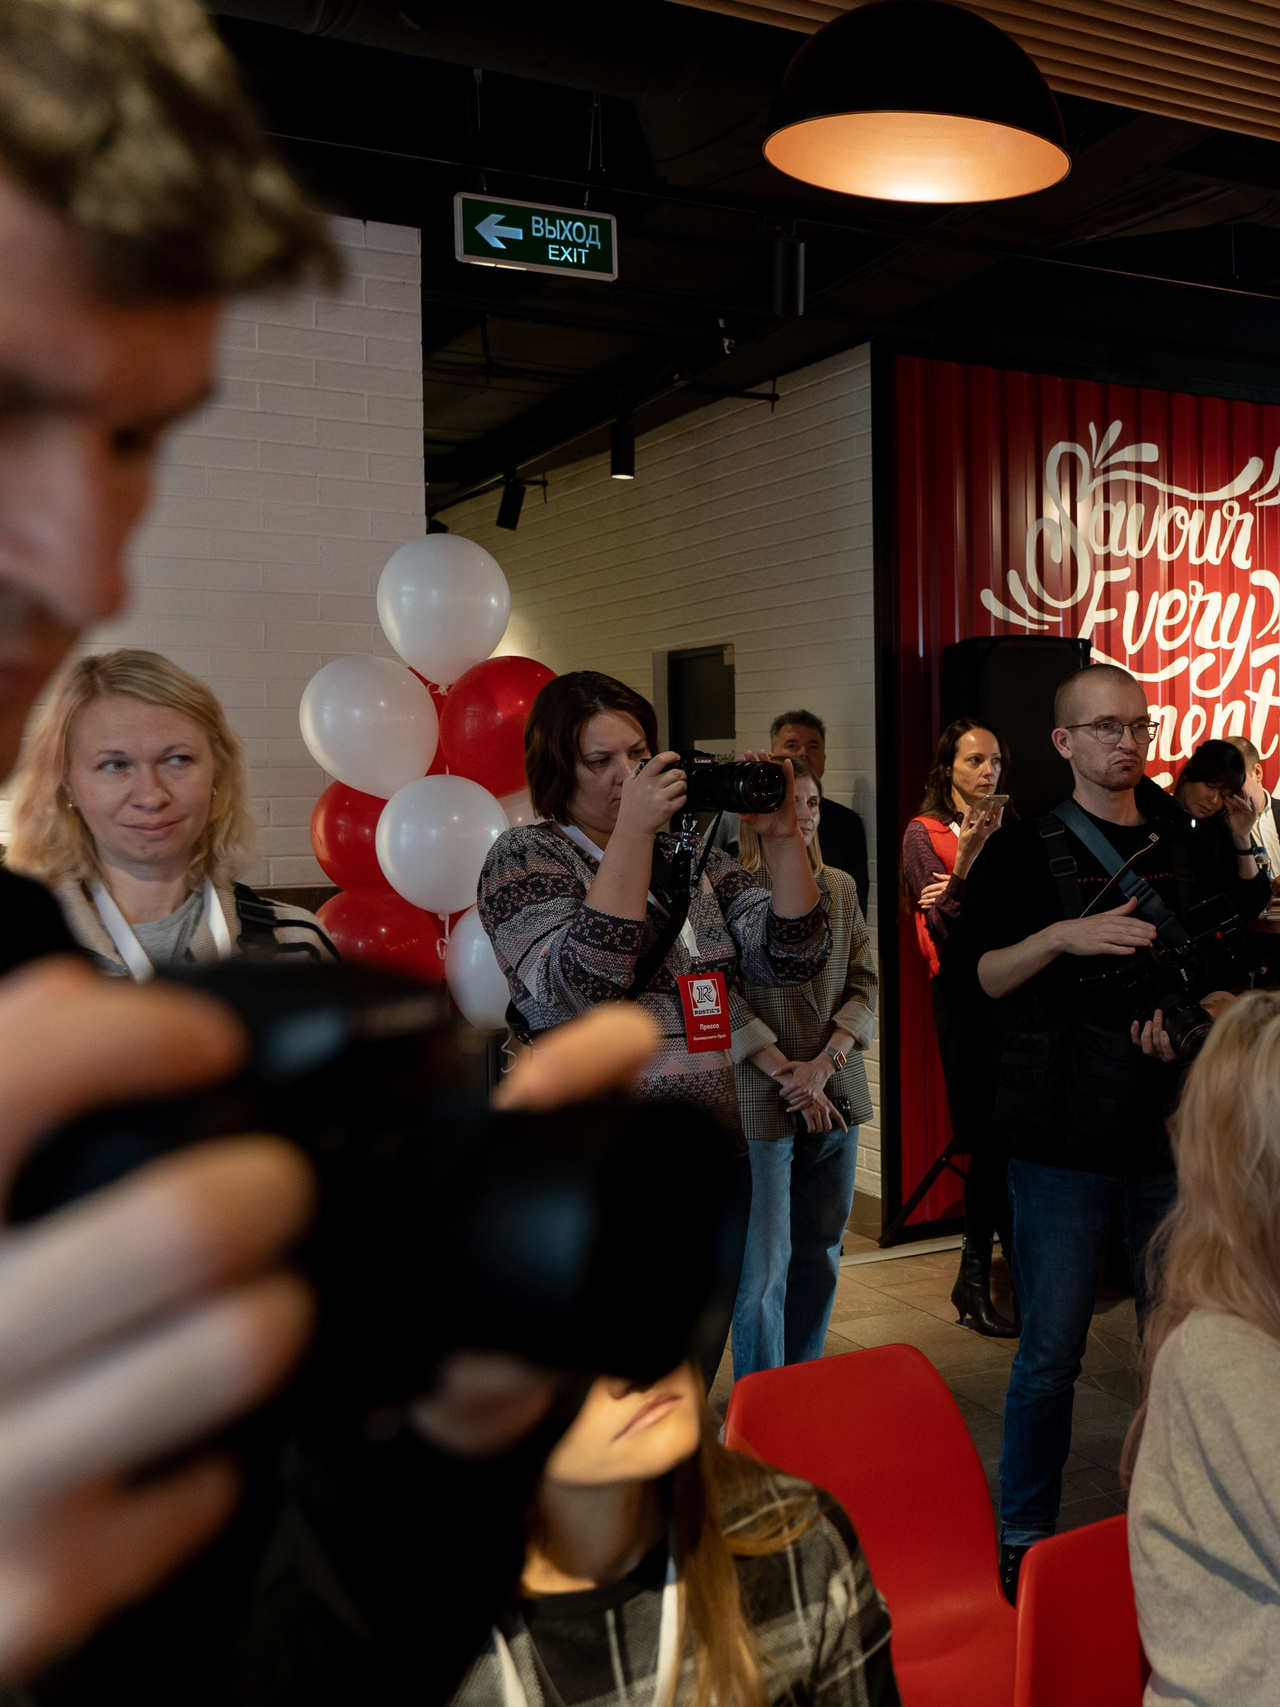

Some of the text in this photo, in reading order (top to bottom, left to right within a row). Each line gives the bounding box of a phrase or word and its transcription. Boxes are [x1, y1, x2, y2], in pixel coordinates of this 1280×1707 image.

[531, 216, 601, 249] ВЫХОД
[548, 244, 589, 264] EXIT
[1026, 440, 1264, 609] Savour
[1078, 567, 1280, 699] Every
